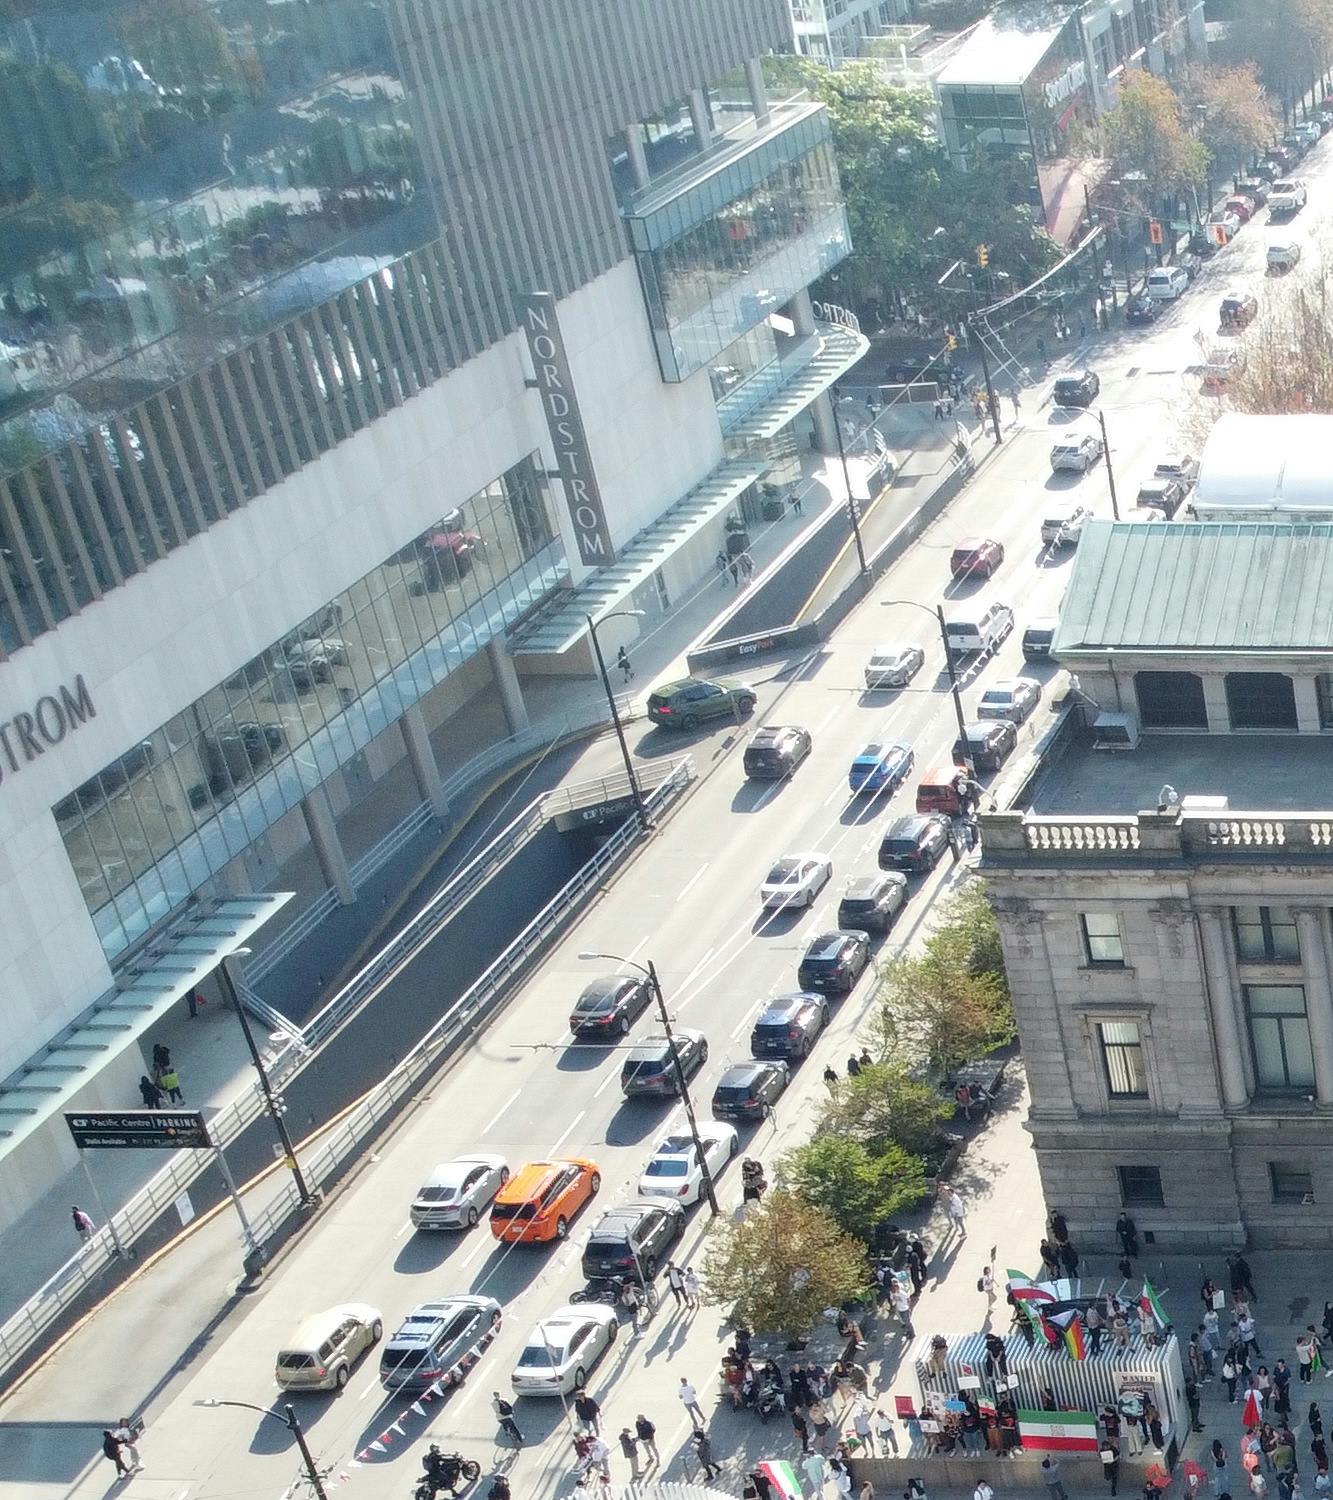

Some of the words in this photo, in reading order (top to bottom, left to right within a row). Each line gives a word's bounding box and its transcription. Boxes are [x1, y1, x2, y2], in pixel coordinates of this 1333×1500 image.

[527, 307, 604, 554] NORDSTROM
[0, 674, 96, 785] TROM
[91, 1119, 119, 1127] Pacific
[121, 1119, 150, 1127] Centre
[157, 1118, 198, 1127] PARKING
